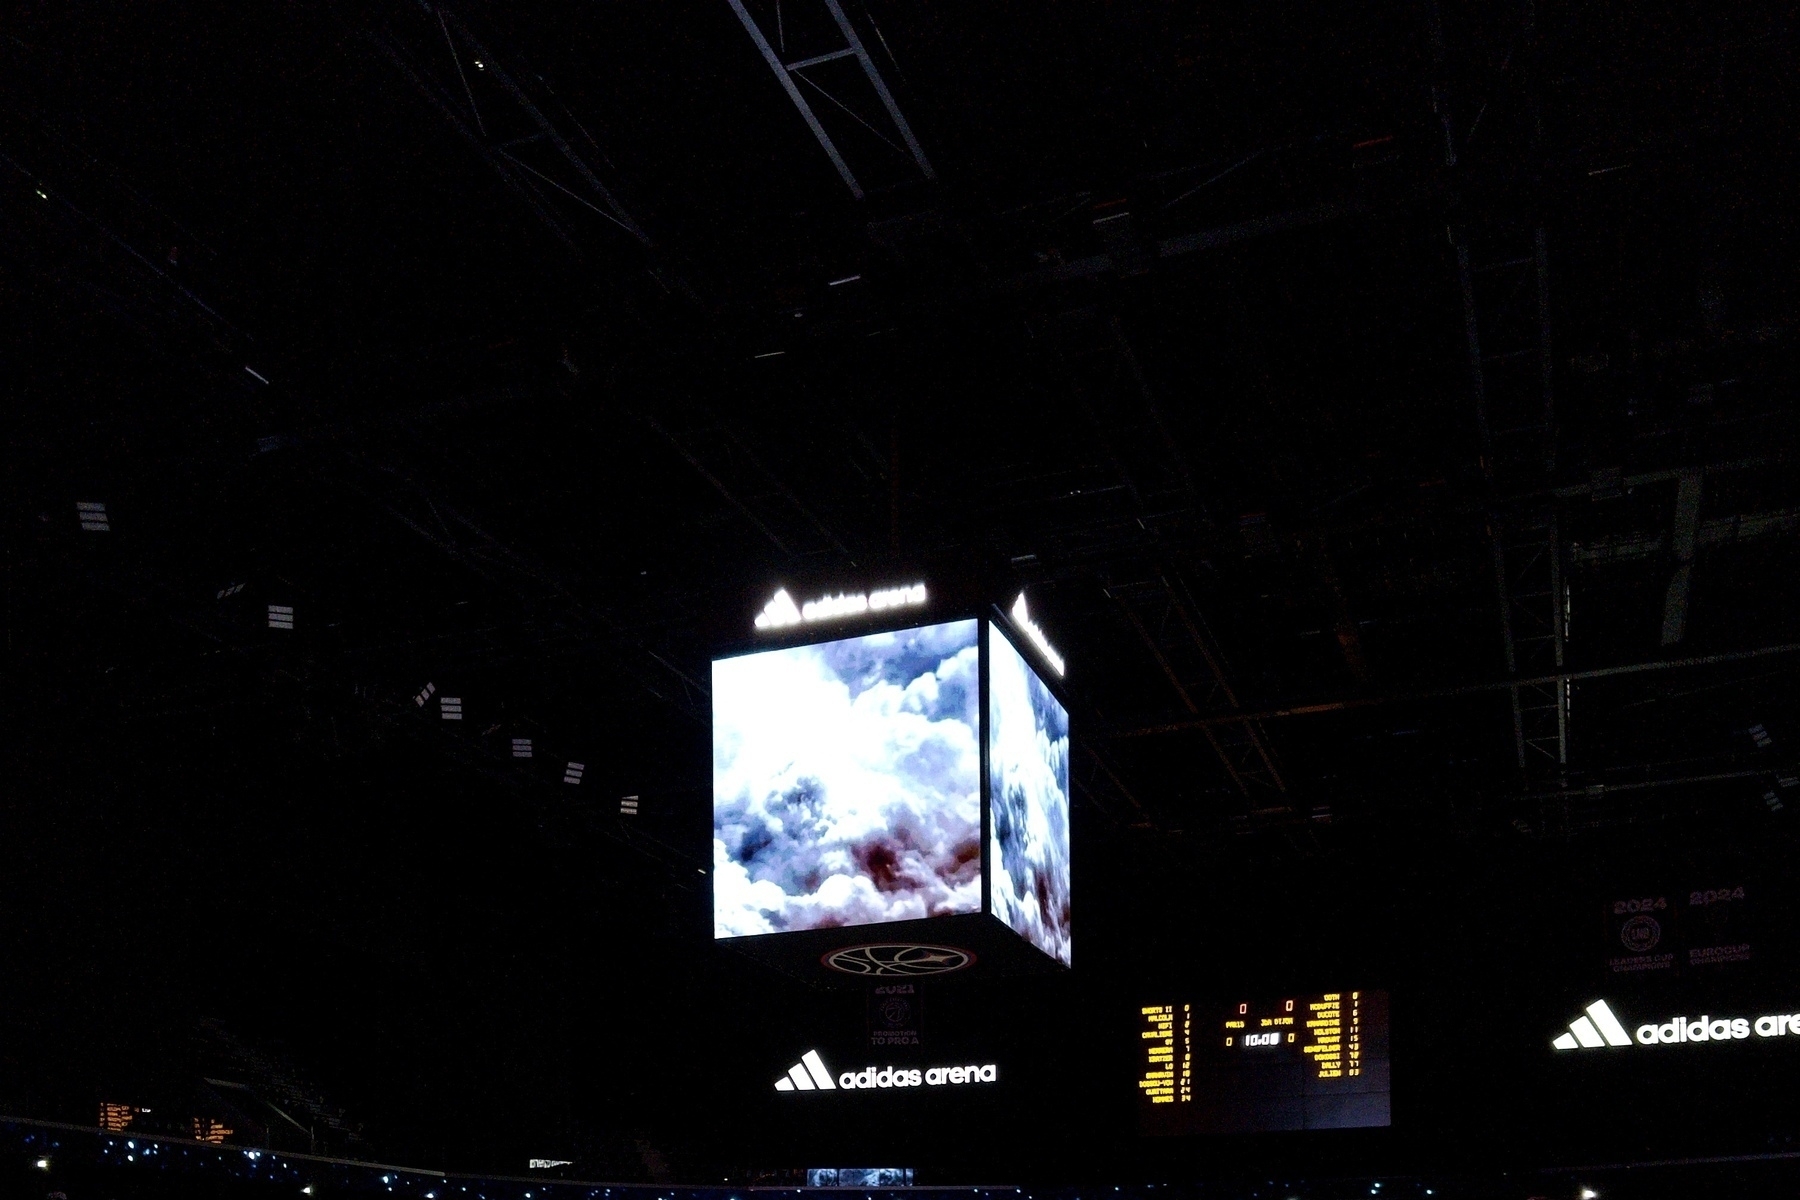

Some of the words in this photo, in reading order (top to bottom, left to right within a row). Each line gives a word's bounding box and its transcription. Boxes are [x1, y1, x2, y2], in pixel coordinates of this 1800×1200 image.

[1689, 886, 1745, 906] 2024
[1613, 897, 1667, 915] 2024
[1240, 1004, 1247, 1014] 0
[1286, 1000, 1293, 1011] 0
[1637, 1016, 1749, 1044] adidas
[1226, 1038, 1232, 1046] 0
[1288, 1033, 1295, 1042] 0
[839, 1066, 922, 1089] adidas
[925, 1065, 996, 1085] arena
